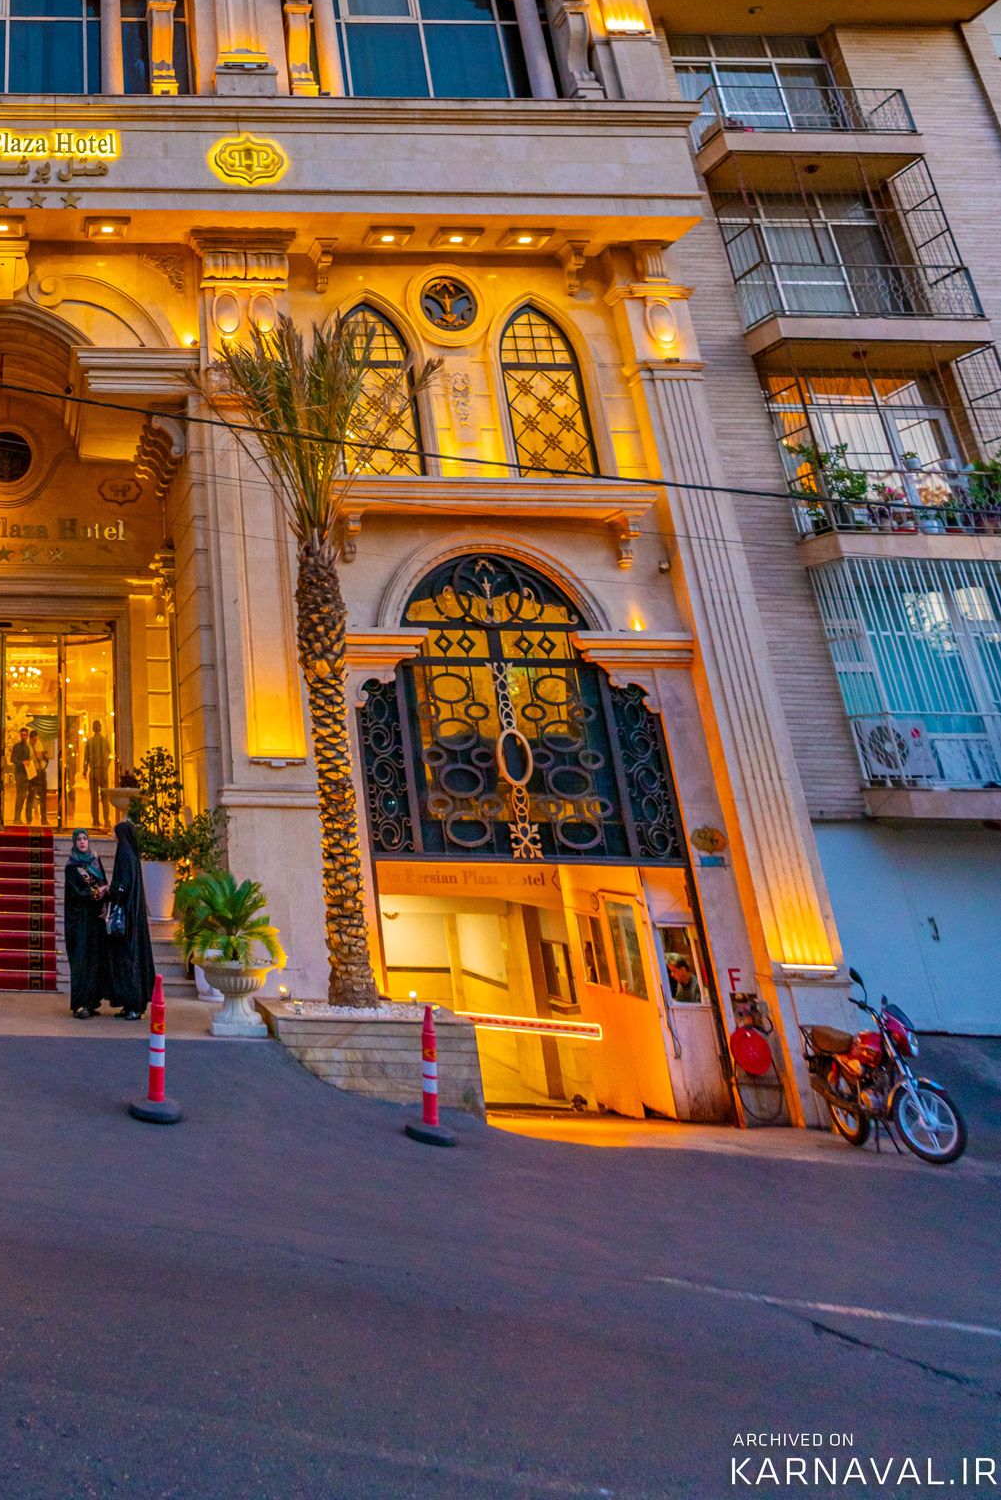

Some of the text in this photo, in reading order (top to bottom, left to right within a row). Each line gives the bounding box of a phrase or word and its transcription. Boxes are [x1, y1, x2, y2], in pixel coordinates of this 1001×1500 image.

[54, 132, 116, 154] Hotel
[57, 156, 109, 182] هتل
[56, 518, 127, 541] Hotel
[727, 968, 741, 991] F
